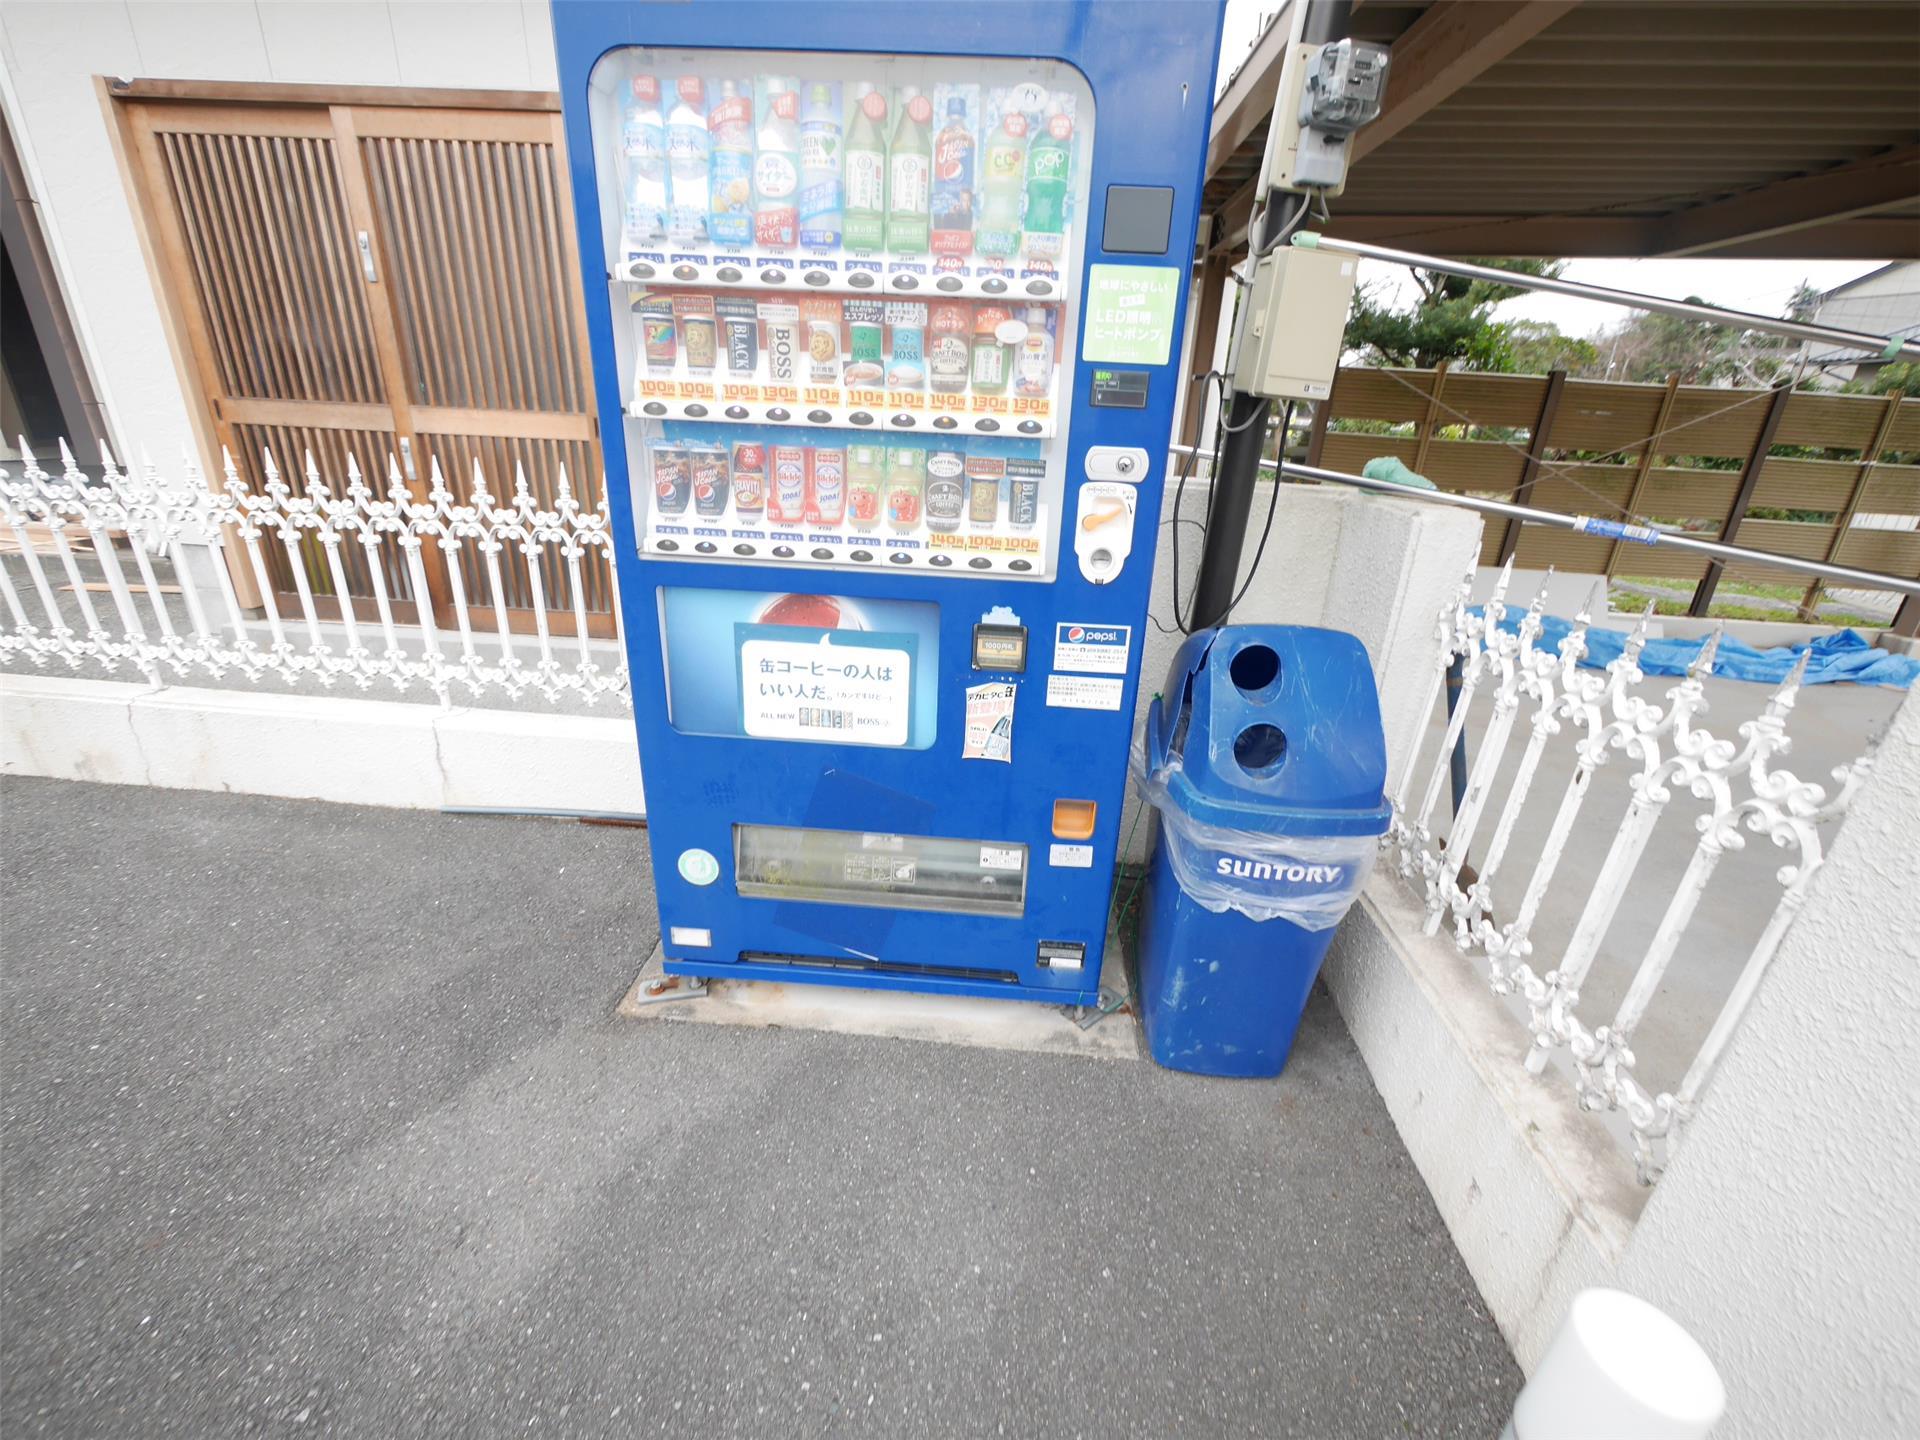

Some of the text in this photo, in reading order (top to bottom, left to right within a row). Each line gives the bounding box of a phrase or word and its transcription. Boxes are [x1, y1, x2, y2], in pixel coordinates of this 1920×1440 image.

[844, 312, 884, 321] エスプレッソ
[1095, 325, 1163, 342] ヒートポンプ
[733, 324, 750, 369] BLACK
[775, 327, 793, 379] BOSS
[894, 350, 919, 360] BOSS
[640, 381, 675, 392] 100円
[679, 382, 714, 394] 100円
[723, 384, 758, 396] 100円
[761, 386, 798, 398] 130円
[805, 388, 840, 400] 110円
[849, 390, 884, 402] 110円
[889, 392, 924, 404] 110円
[930, 394, 966, 406] 140円
[972, 396, 1008, 408] 130円
[1013, 398, 1049, 410] 130円
[1021, 483, 1034, 522] BLACK
[930, 534, 965, 546] 140円
[967, 536, 1002, 547] 100円
[1004, 537, 1039, 549] 100円
[1086, 631, 1117, 642] pepsi
[759, 657, 893, 682] 缶コーヒーの人は
[759, 682, 833, 701] いい人だ。
[776, 712, 796, 720] NEW
[857, 717, 881, 726] BOSS
[1216, 857, 1341, 883] SUNTORY
